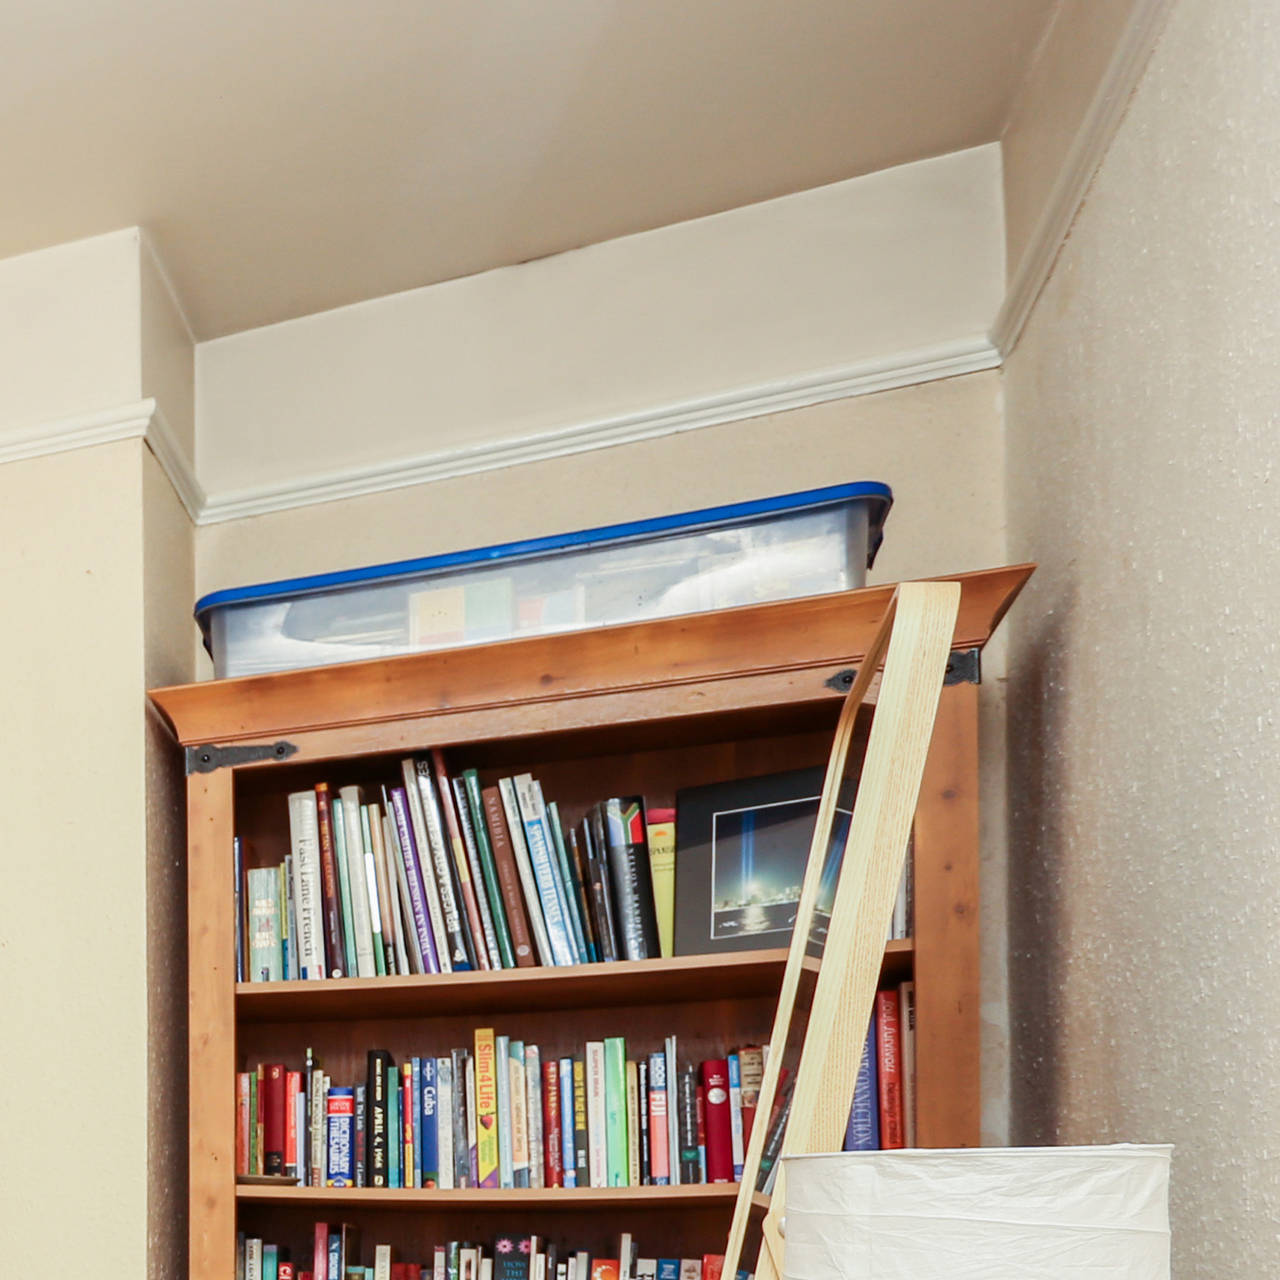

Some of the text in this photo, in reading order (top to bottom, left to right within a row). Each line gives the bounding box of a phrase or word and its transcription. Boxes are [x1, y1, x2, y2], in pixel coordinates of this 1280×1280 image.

[488, 796, 504, 849] NAMIBIA
[527, 824, 550, 863] SPANISH
[298, 838, 318, 958] Fast Lane French
[478, 1043, 494, 1109] Slim 4 Life
[656, 1057, 666, 1086] MOON
[374, 1106, 383, 1135] APRIL
[424, 1086, 436, 1116] Cuba
[651, 1094, 666, 1116] FIJI
[340, 1117, 351, 1174] DICTIONARY
